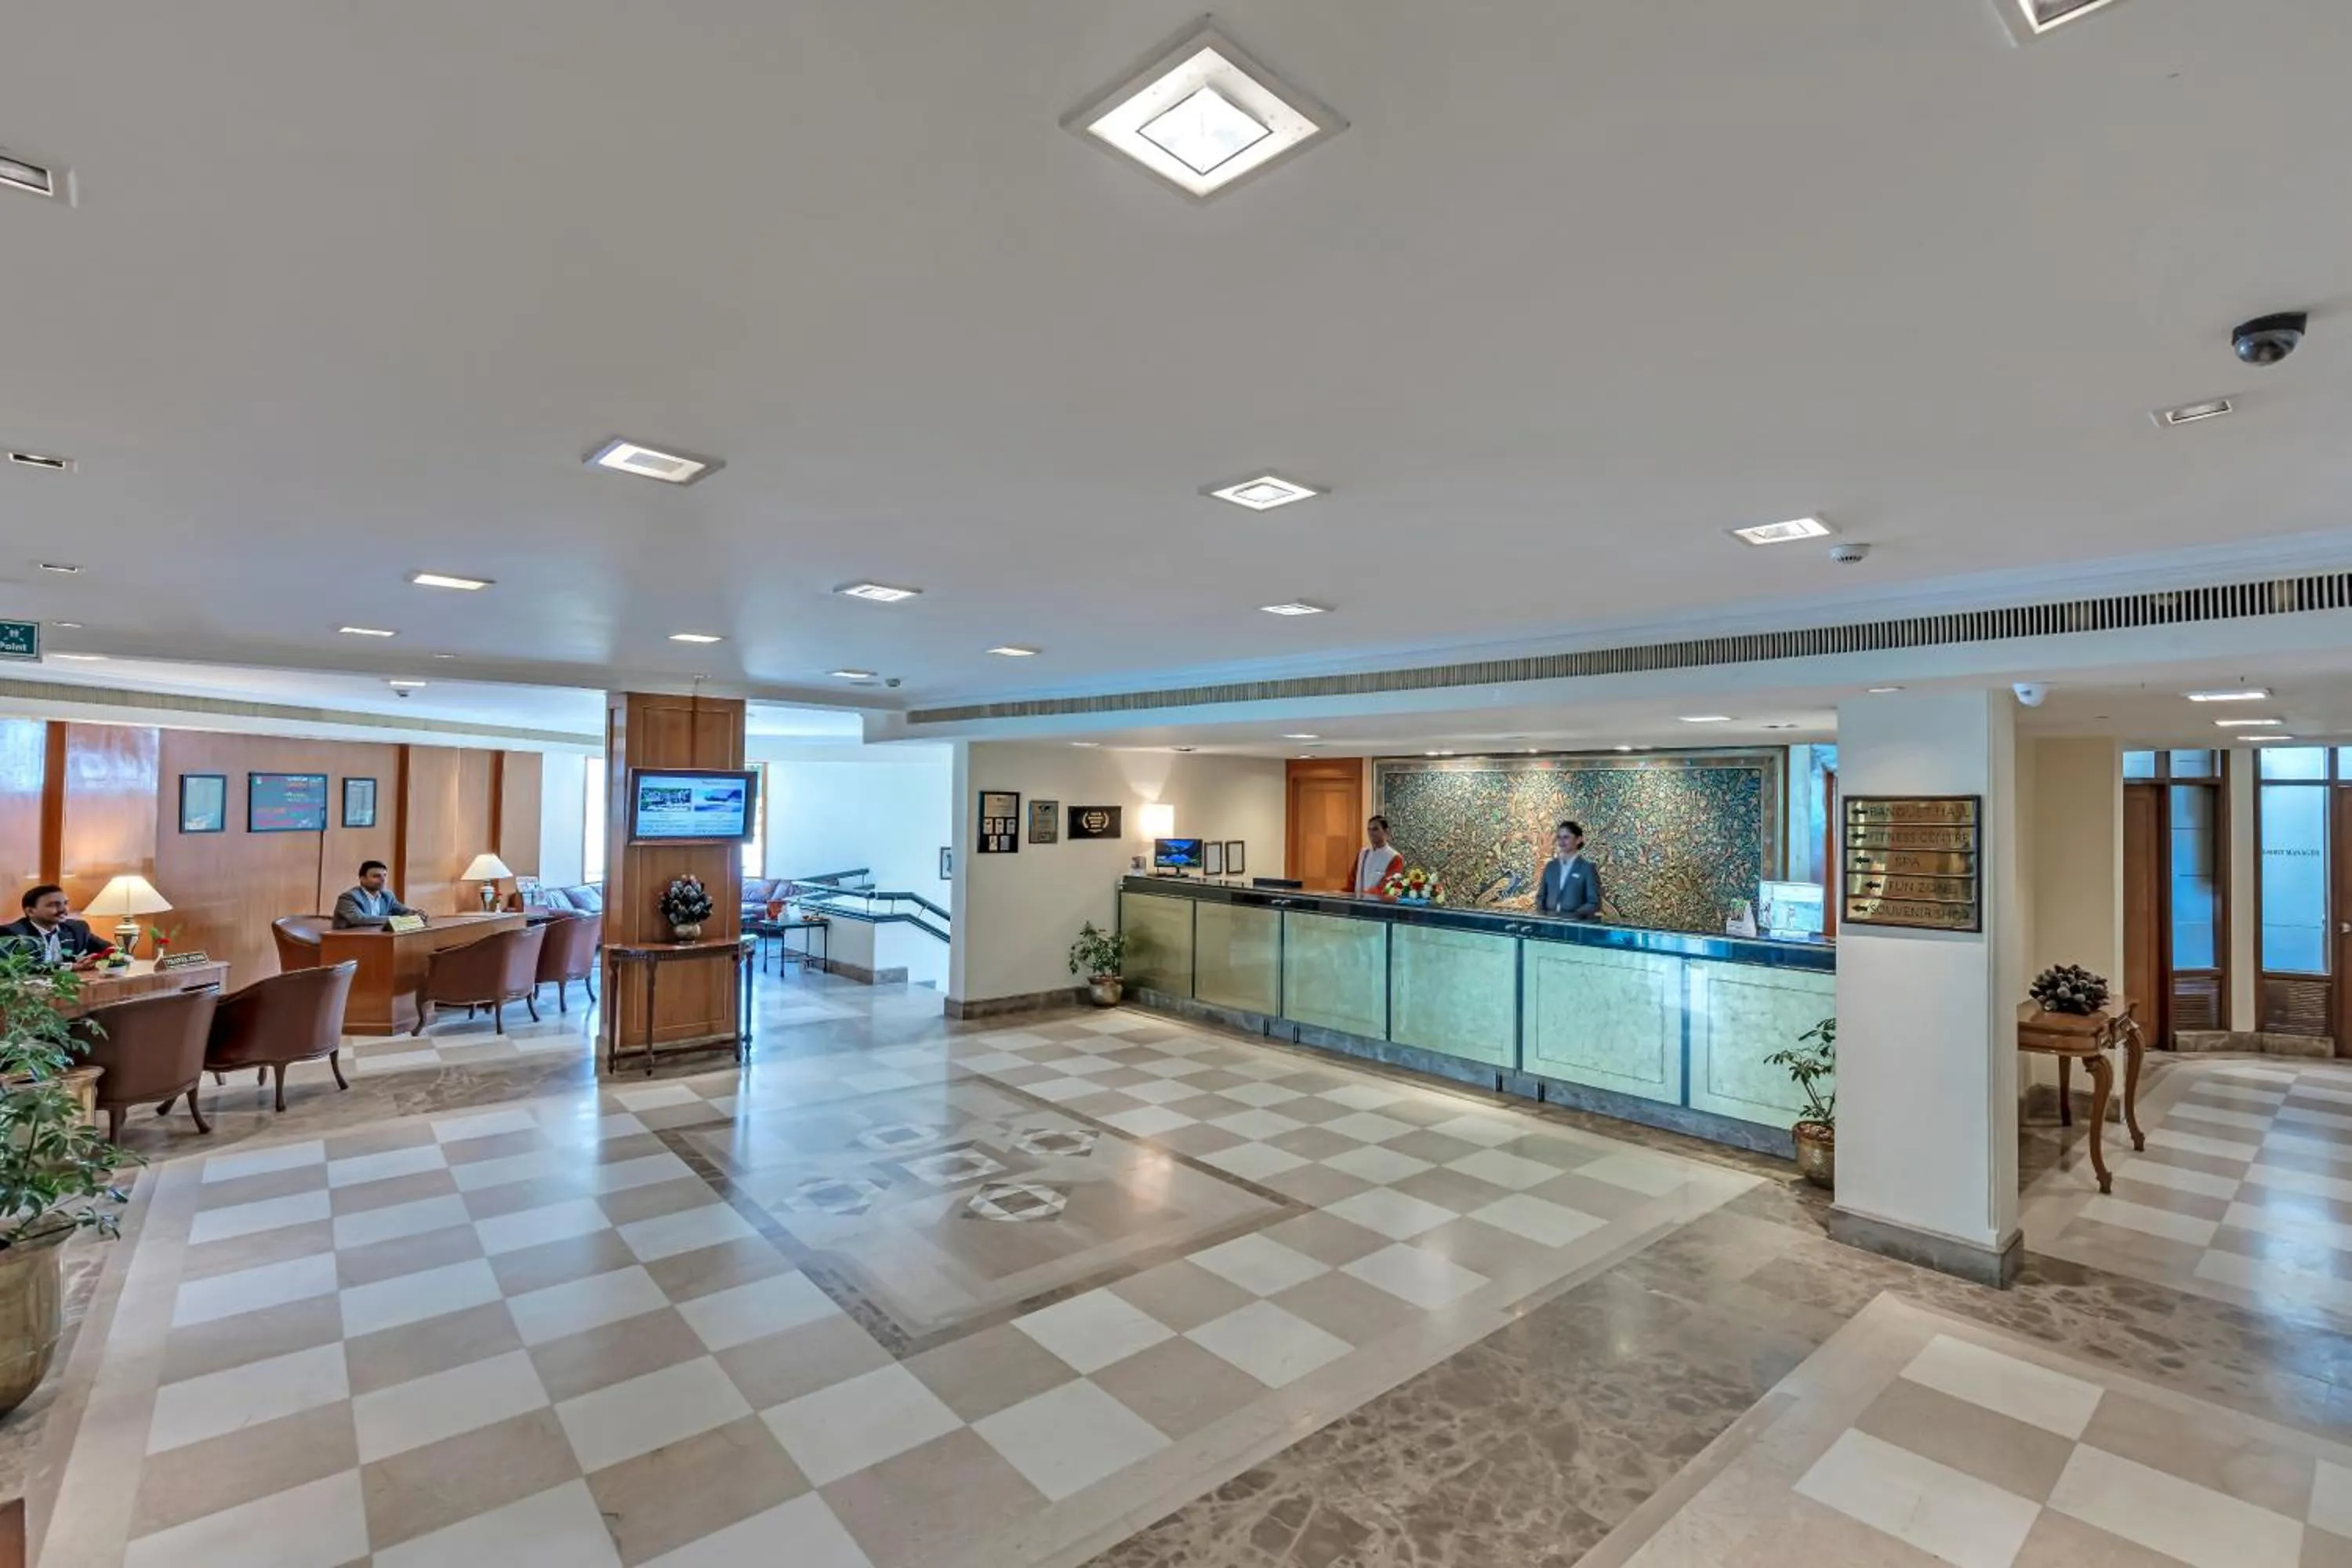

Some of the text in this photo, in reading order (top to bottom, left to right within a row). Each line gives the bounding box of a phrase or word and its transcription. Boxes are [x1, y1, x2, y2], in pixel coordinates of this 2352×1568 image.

[1895, 856, 1920, 866] SPA
[1918, 881, 1958, 895] ZONE
[1870, 904, 1969, 920] SOUVENIR SHOP
